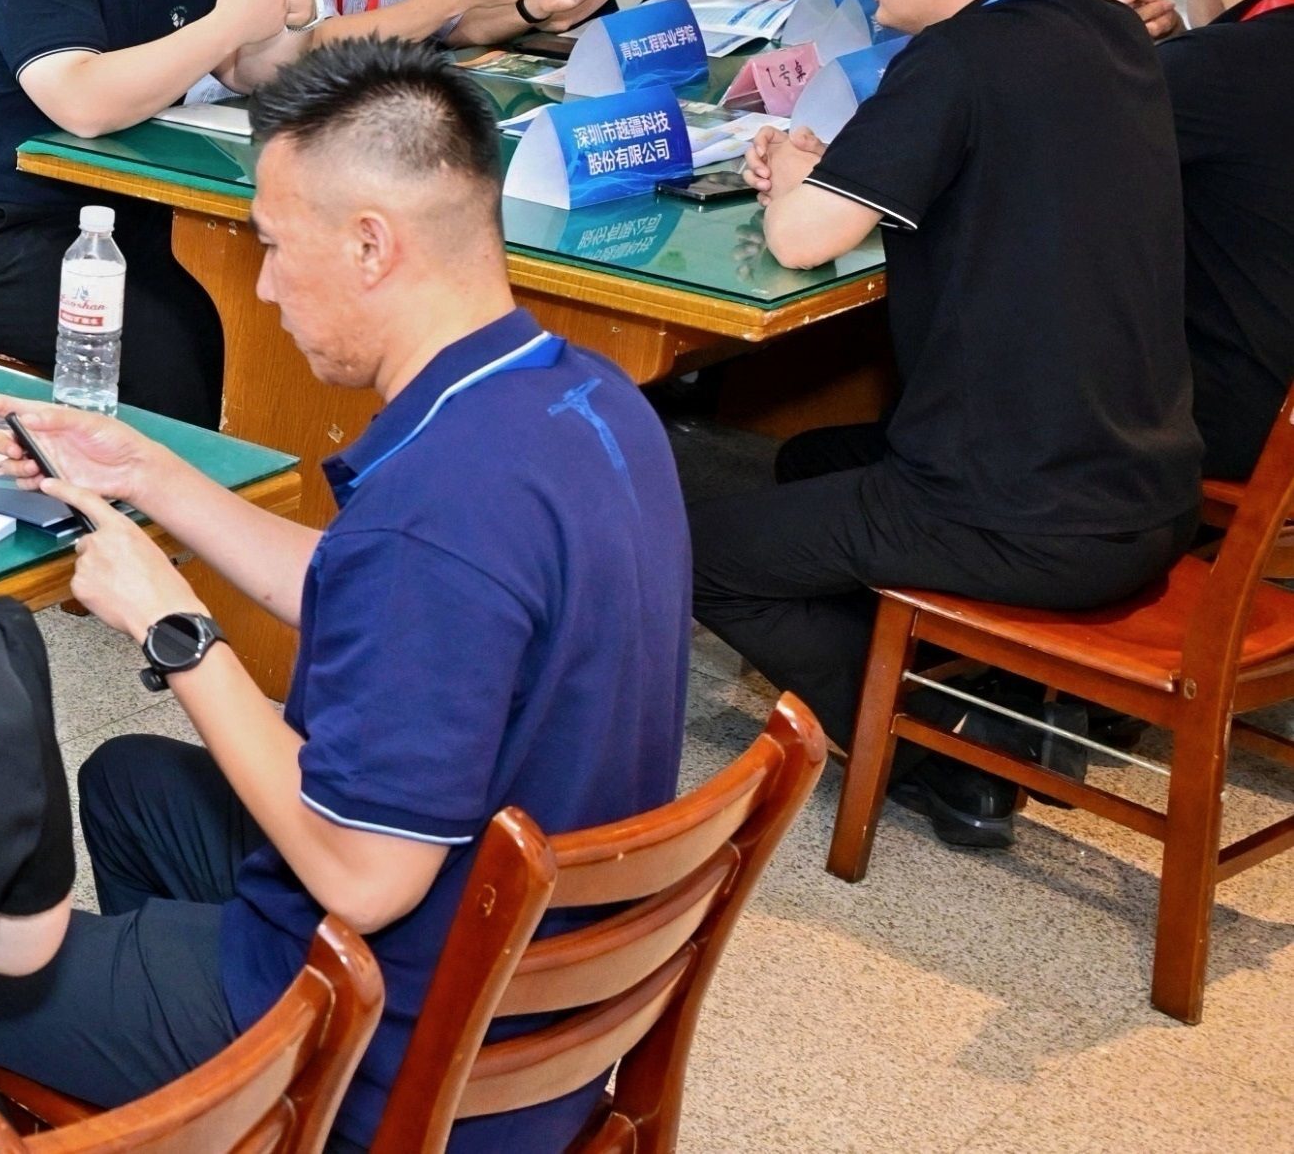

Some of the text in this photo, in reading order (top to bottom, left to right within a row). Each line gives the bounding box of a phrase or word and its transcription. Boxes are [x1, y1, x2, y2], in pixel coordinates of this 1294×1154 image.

[620, 24, 698, 61] 青岛工程职业学院
[573, 110, 672, 149] 深圳市越疆科技
[587, 138, 671, 176] 股份有限公司
